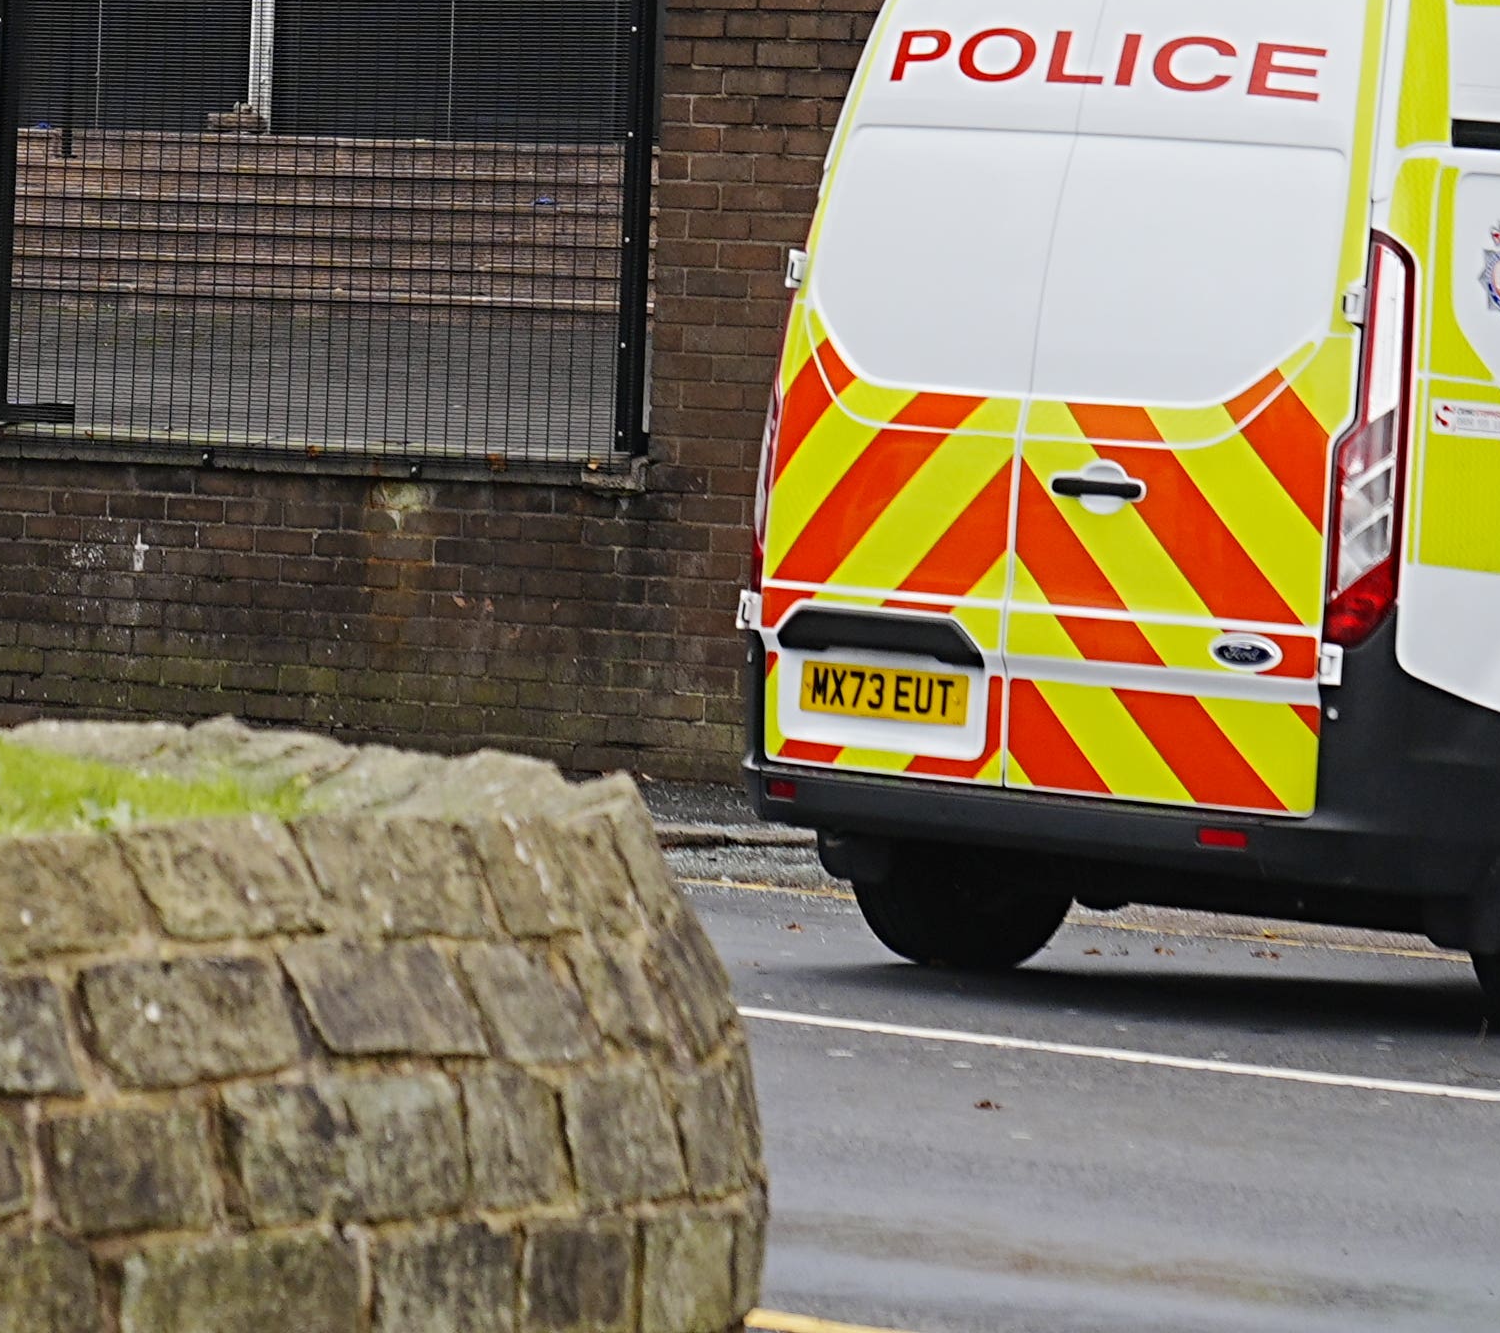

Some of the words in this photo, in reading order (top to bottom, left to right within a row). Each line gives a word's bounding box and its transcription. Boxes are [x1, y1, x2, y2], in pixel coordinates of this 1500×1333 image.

[890, 28, 1327, 102] POLICE
[811, 667, 885, 709] MX73
[894, 675, 955, 716] EUT
